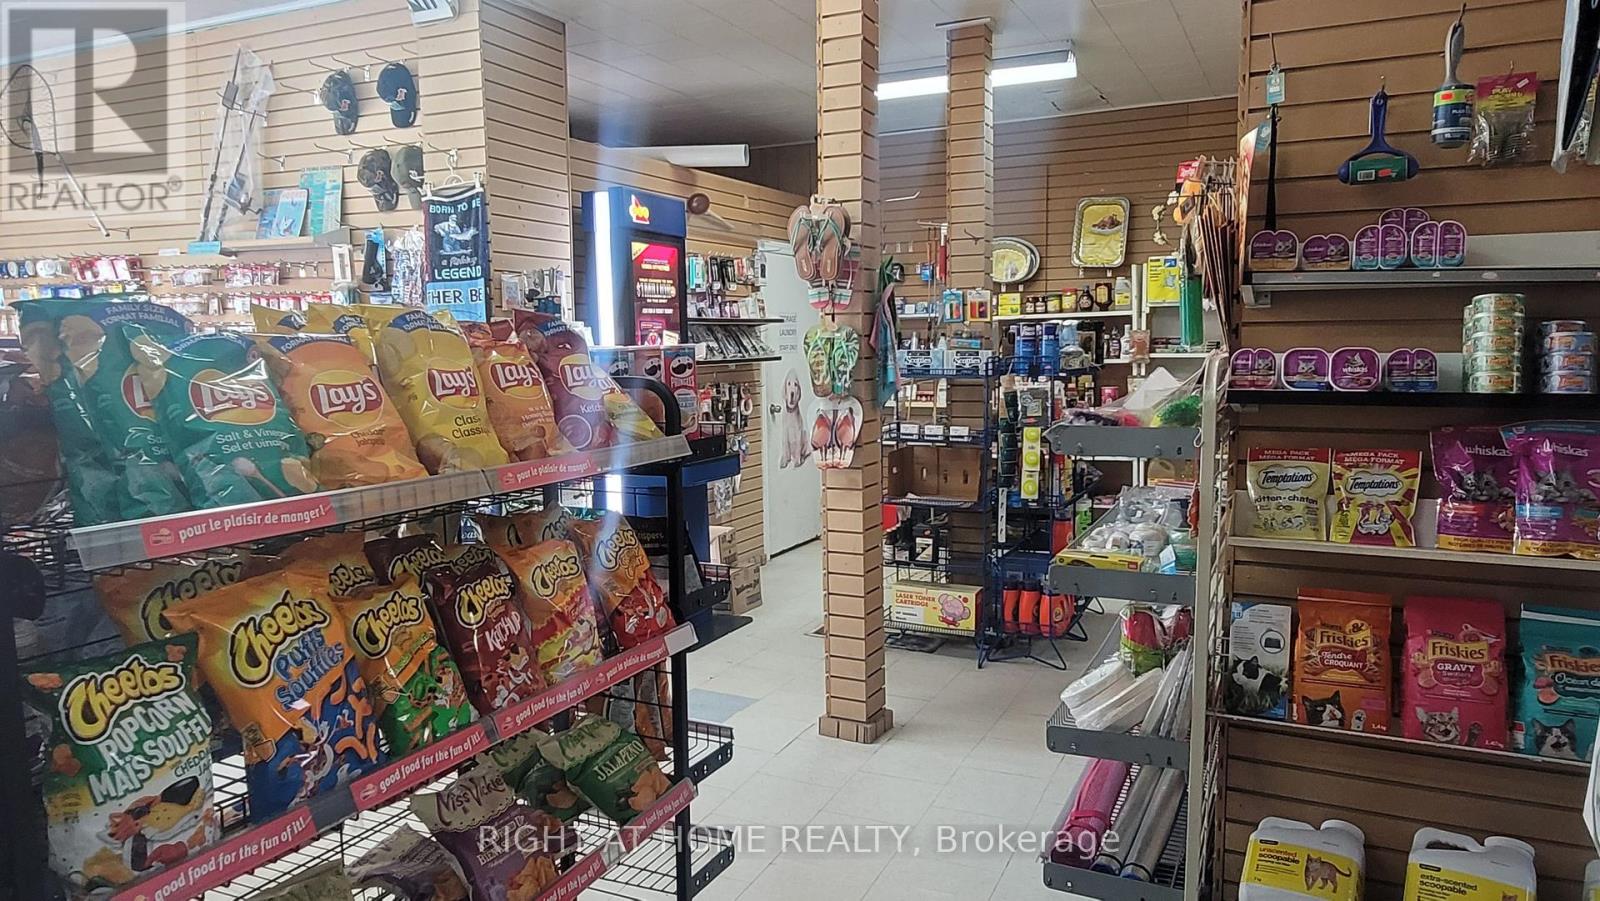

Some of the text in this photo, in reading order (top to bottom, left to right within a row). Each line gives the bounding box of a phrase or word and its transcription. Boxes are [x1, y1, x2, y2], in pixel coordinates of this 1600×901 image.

[429, 204, 455, 214] BORN
[457, 202, 468, 212] TO
[434, 265, 482, 280] LEGEND
[106, 303, 167, 315] FAMILY SIZE
[100, 311, 181, 328] FORMAT FAMILIAL
[433, 365, 476, 398] Lay's
[317, 376, 379, 415] Lay's
[215, 431, 241, 444] Salt
[243, 429, 254, 439] &
[221, 441, 240, 454] Sel
[241, 439, 253, 451] et
[1465, 444, 1513, 457] whiskas
[516, 468, 531, 483] pour
[531, 466, 539, 477] le
[538, 464, 559, 477] plaisir
[559, 463, 567, 473] de
[1262, 470, 1314, 489] Temptations
[1349, 476, 1401, 495] Temptations
[178, 504, 326, 544] pour le plaisir de manger!
[530, 554, 581, 600] Cheetos
[455, 574, 513, 629] Cheetos
[895, 592, 936, 602] LASER TONER
[895, 599, 929, 608] CARTRIDGE
[352, 591, 423, 658] Cheetos
[485, 611, 521, 652] KETCHUP
[231, 588, 331, 689] Cheetos
[1319, 630, 1369, 649] Friskies
[1431, 641, 1486, 660] Friskies
[1323, 658, 1364, 670] CROQUANT
[1437, 662, 1477, 673] GRAVY
[606, 668, 617, 682] pour
[1554, 672, 1589, 686] Ocean
[59, 655, 186, 745] Cheetos
[515, 707, 531, 726] good
[531, 701, 546, 717] food
[546, 696, 557, 710] for
[556, 692, 567, 706] the
[566, 688, 578, 702] fun
[97, 688, 199, 771] POPCORN
[379, 768, 401, 794] good
[400, 758, 421, 780] food
[420, 753, 434, 771] for
[435, 749, 449, 763] the
[448, 743, 463, 760] fun
[463, 738, 473, 752] of
[1258, 853, 1300, 865] scoopable
[1259, 847, 1298, 858] unscented
[154, 871, 186, 901] good
[187, 856, 216, 886] food
[217, 848, 237, 872] for
[238, 841, 259, 862] the
[259, 834, 280, 857] fun
[280, 825, 293, 844] of
[1418, 880, 1468, 896] scoopable
[1420, 873, 1478, 891] extra-scented
